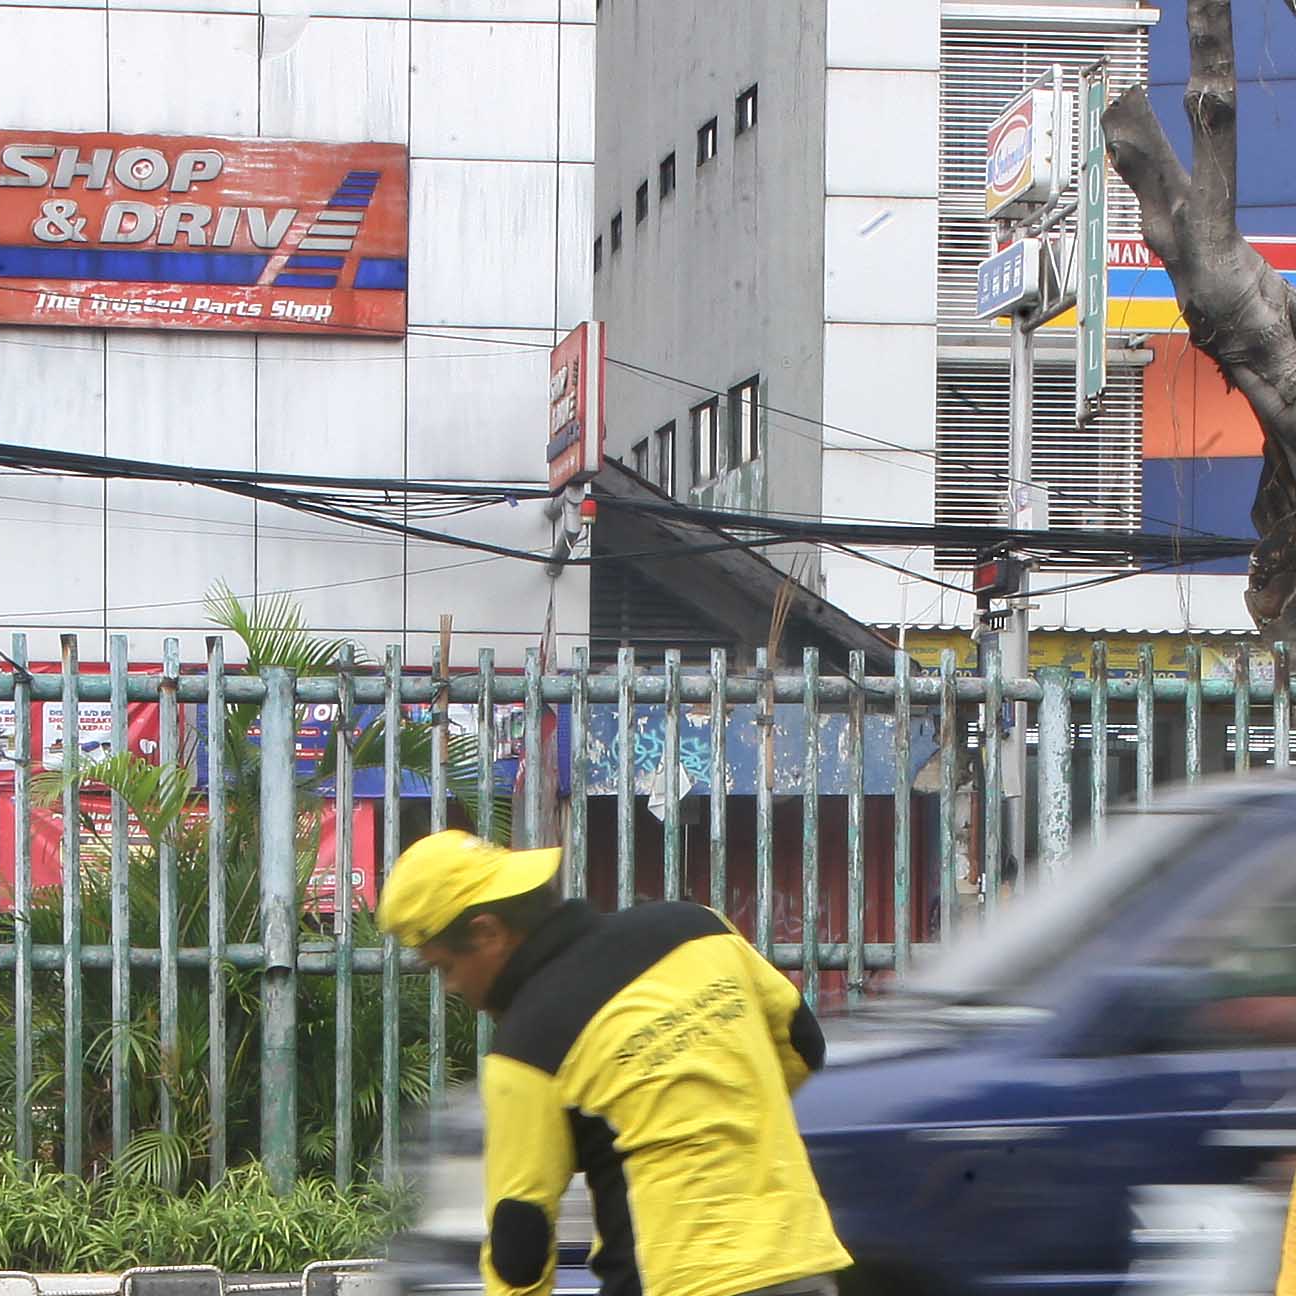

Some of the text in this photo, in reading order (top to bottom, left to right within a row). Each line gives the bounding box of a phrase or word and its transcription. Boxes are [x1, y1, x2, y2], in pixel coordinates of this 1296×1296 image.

[33, 199, 88, 243] &
[1088, 106, 1102, 372] HOTEL
[35, 291, 334, 321] The Trusted Parts Shop
